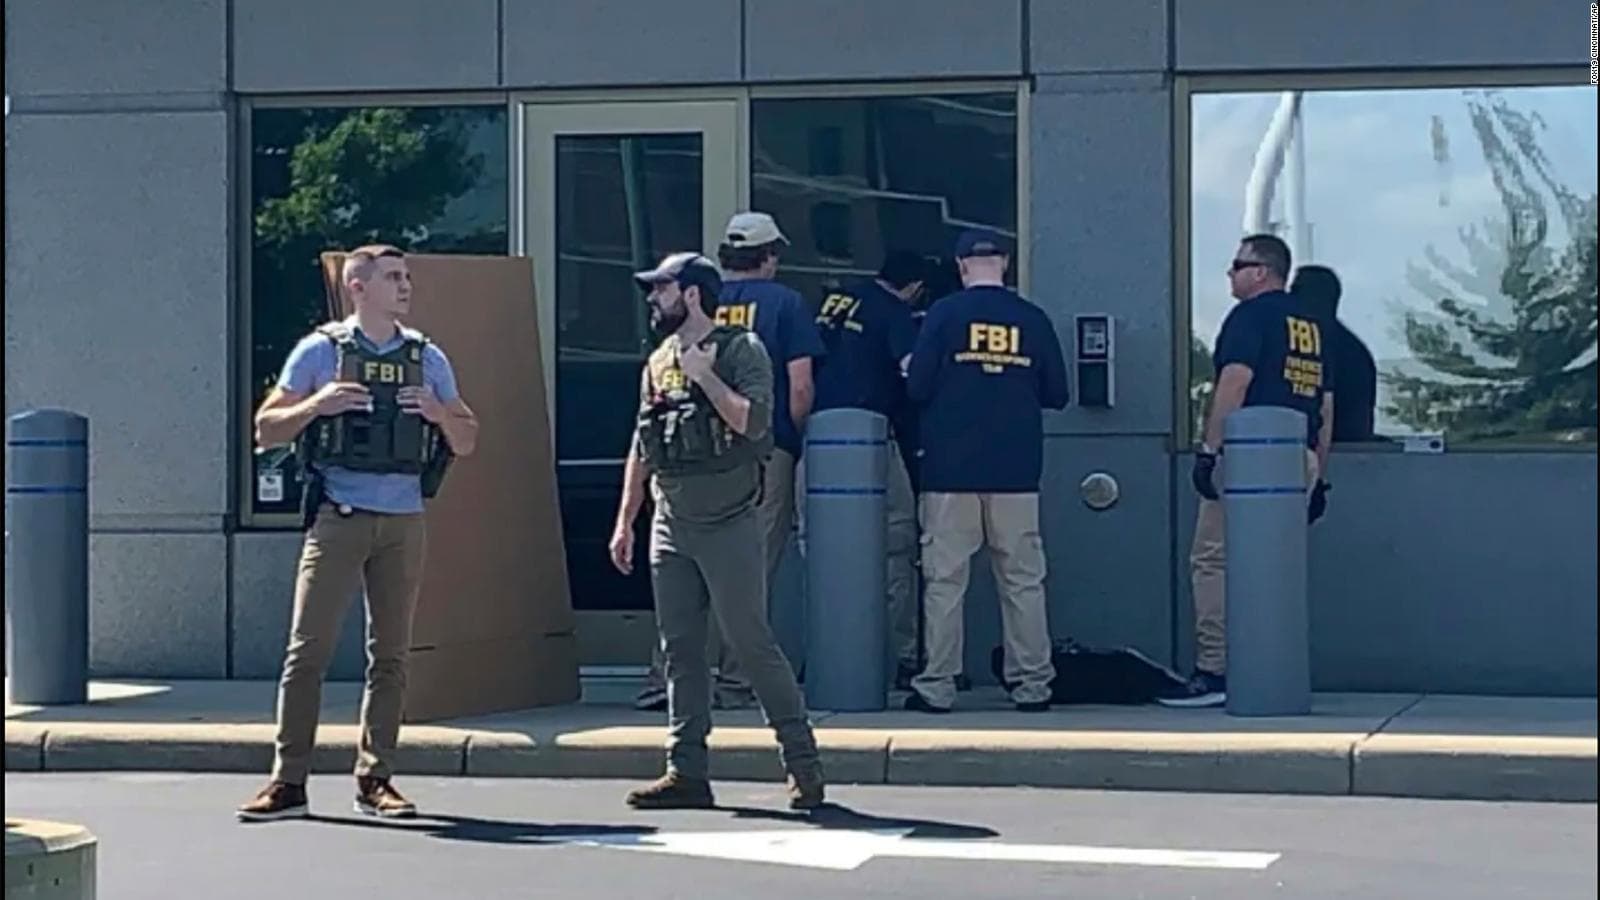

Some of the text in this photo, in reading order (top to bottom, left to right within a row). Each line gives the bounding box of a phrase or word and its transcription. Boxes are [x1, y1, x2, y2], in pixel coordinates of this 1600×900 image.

[970, 322, 1020, 354] FBI
[1286, 315, 1321, 356] FBI
[365, 362, 404, 384] FBI
[662, 368, 687, 390] FB
